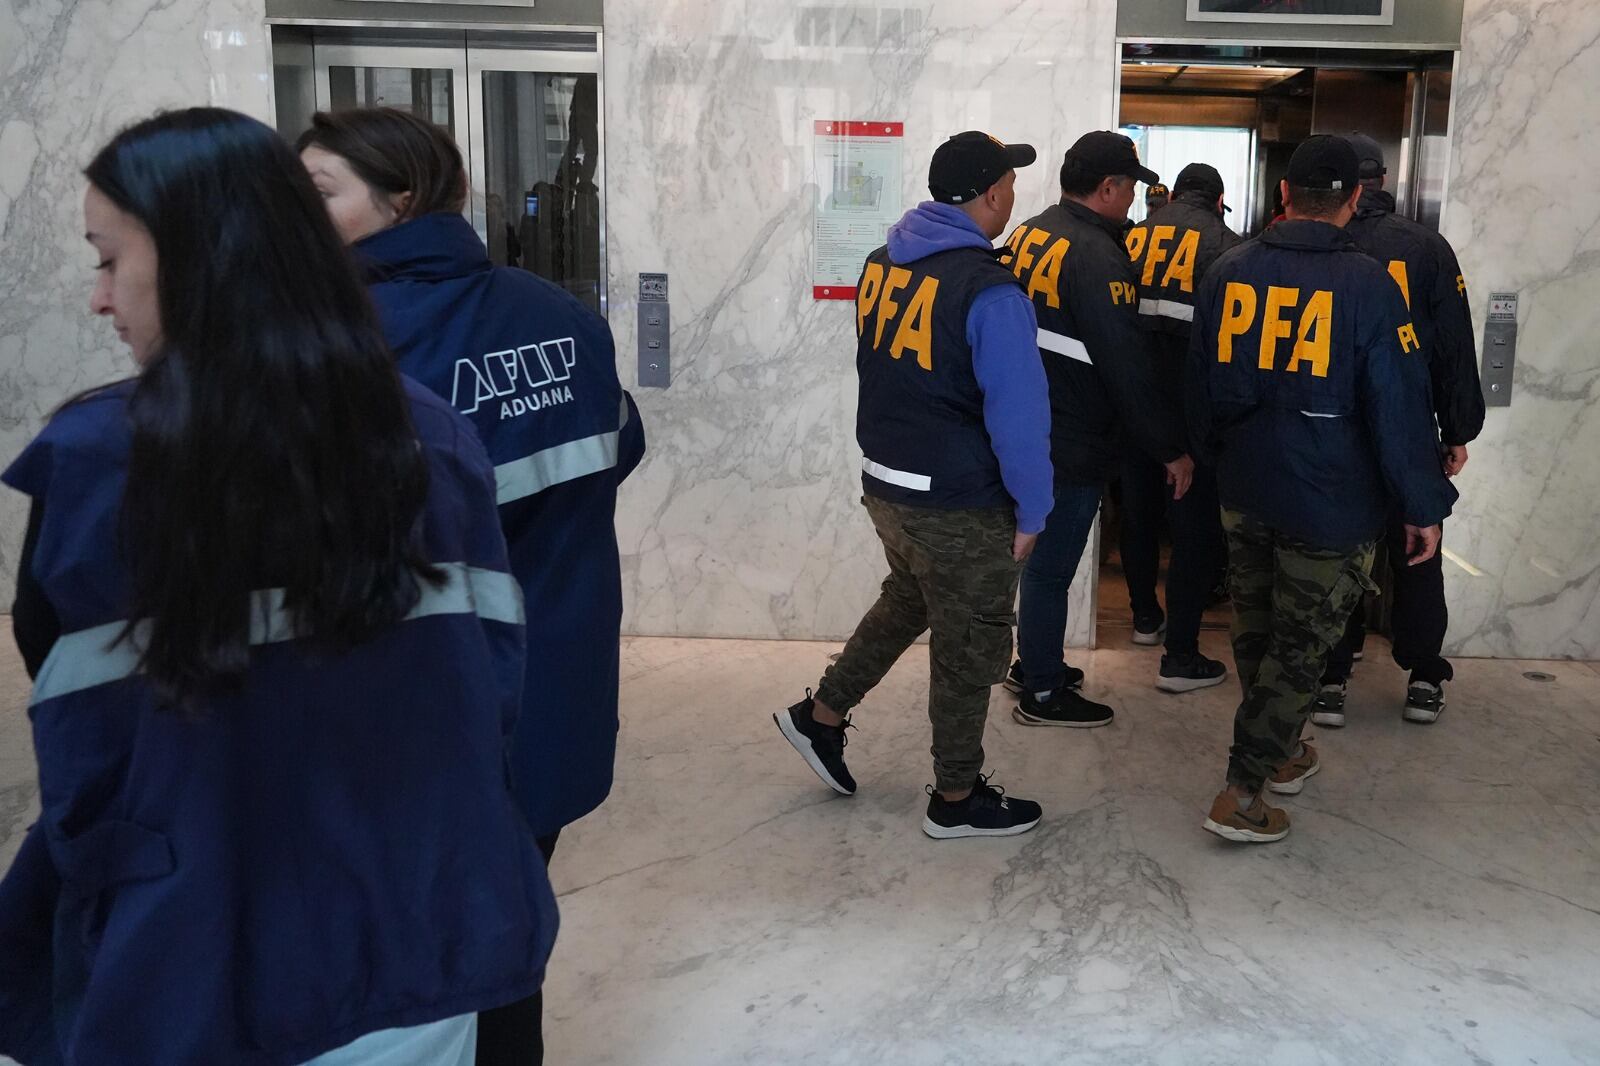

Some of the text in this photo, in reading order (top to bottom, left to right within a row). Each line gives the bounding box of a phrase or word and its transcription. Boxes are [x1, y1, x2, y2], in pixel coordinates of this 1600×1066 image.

[857, 262, 939, 371] PFA
[1217, 281, 1333, 378] PFA
[451, 337, 576, 414] AFIP
[500, 386, 574, 420] ADUANA
